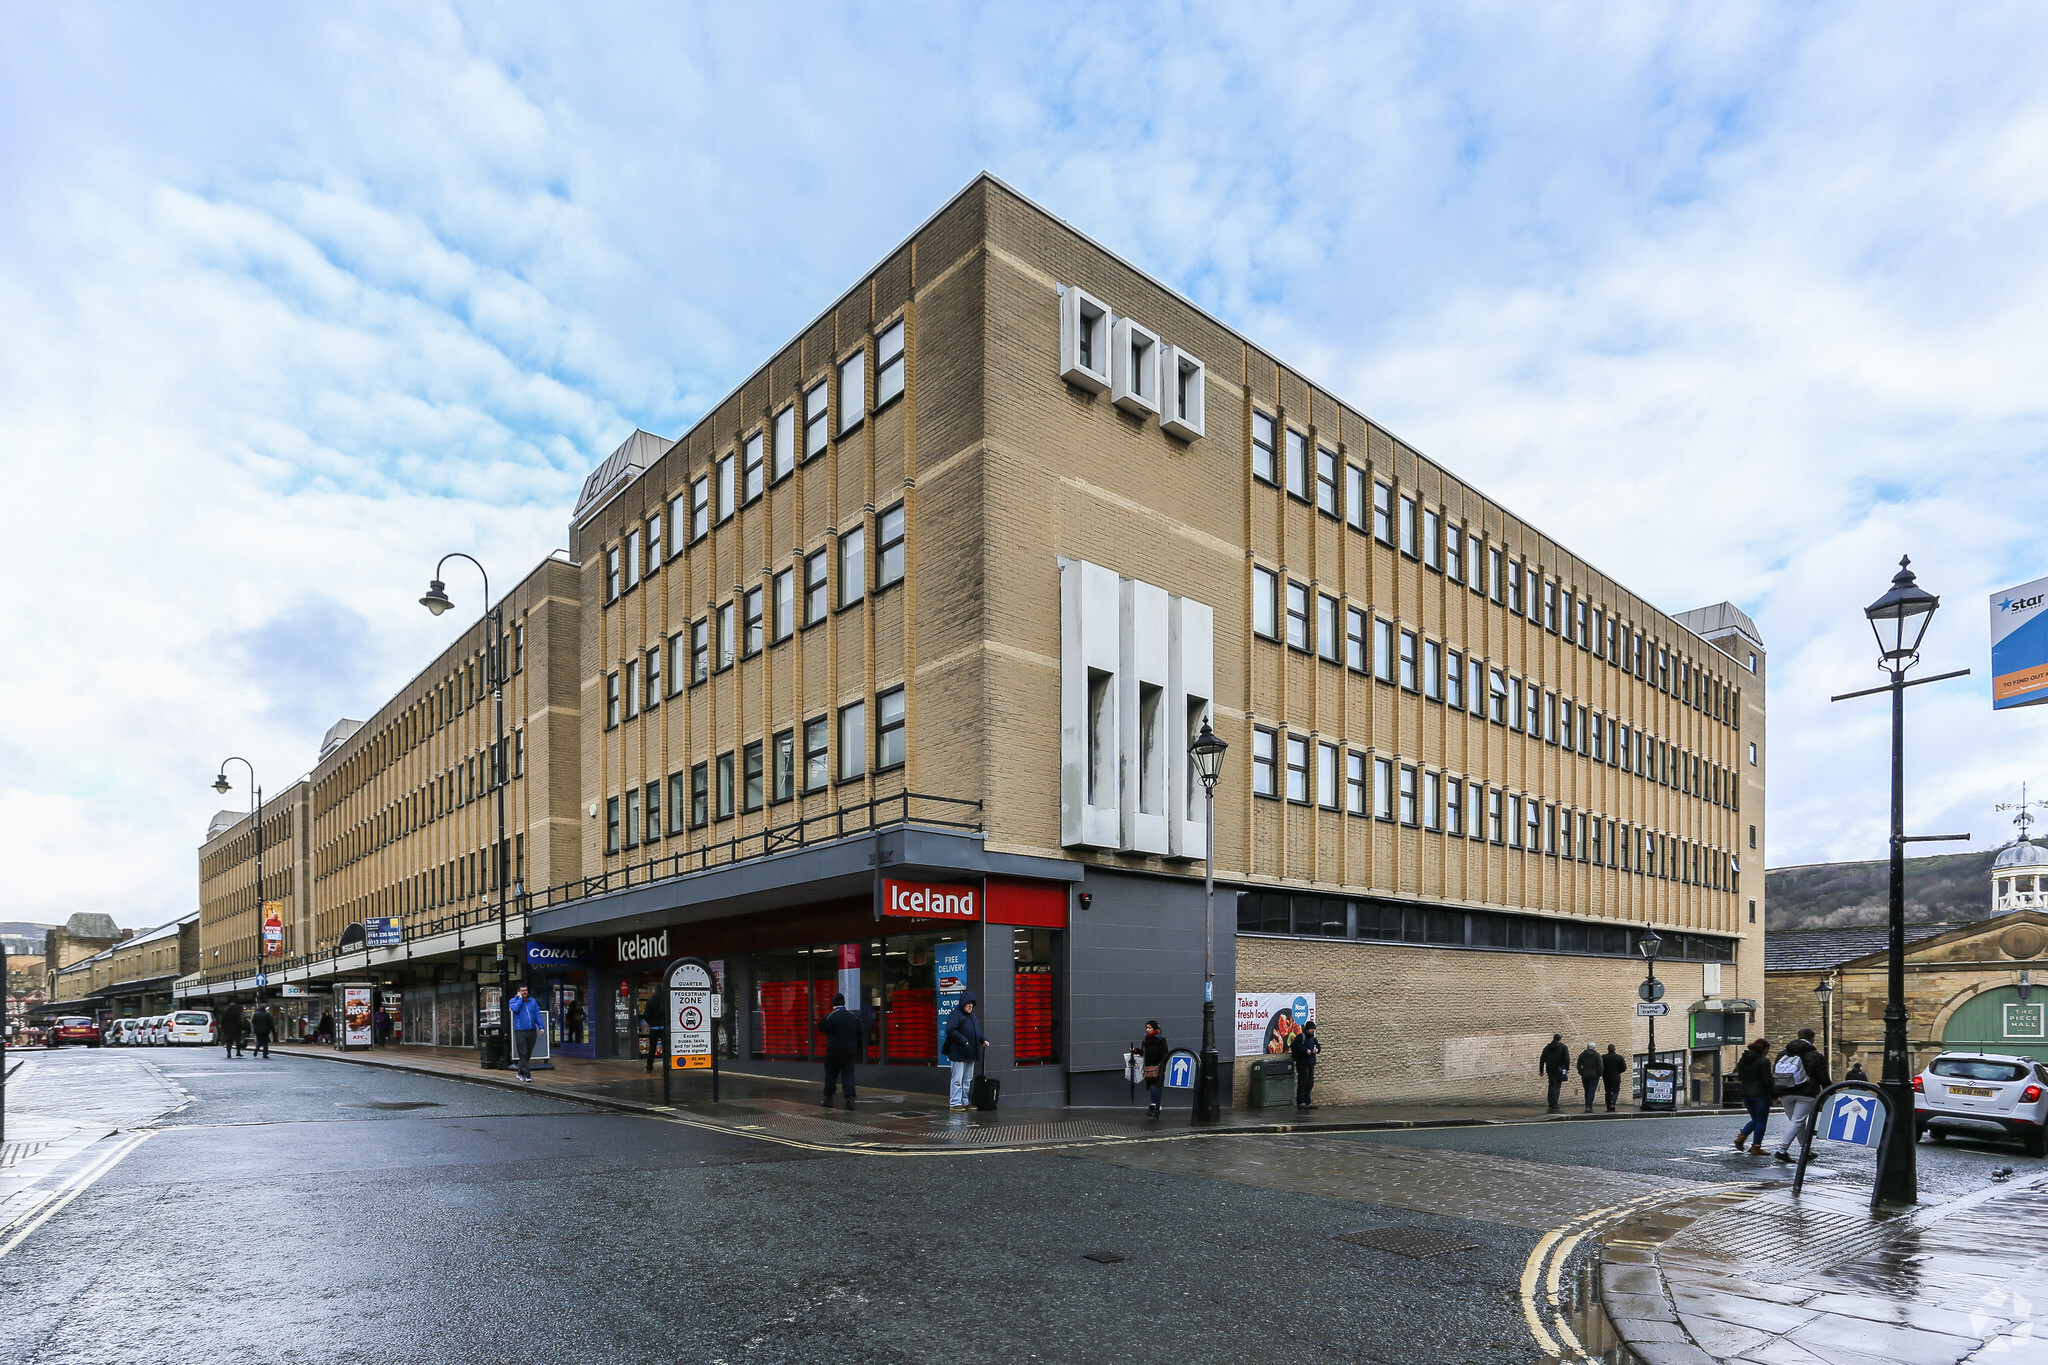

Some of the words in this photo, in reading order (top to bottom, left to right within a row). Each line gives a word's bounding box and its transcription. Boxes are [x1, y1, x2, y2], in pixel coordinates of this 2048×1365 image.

[2012, 594, 2044, 611] star
[2012, 677, 2029, 685] FIND
[2030, 672, 2044, 680] OUT
[891, 885, 973, 915] Iceland
[618, 930, 667, 962] Iceland
[529, 948, 578, 958] CORAL
[944, 956, 959, 964] FREE
[675, 966, 705, 976] MARKET
[938, 964, 965, 973] DELIVERY
[1238, 998, 1253, 1007] Take
[1238, 1010, 1254, 1019] fresh
[1255, 1009, 1269, 1018] look
[1238, 1021, 1265, 1031] Halifax...
